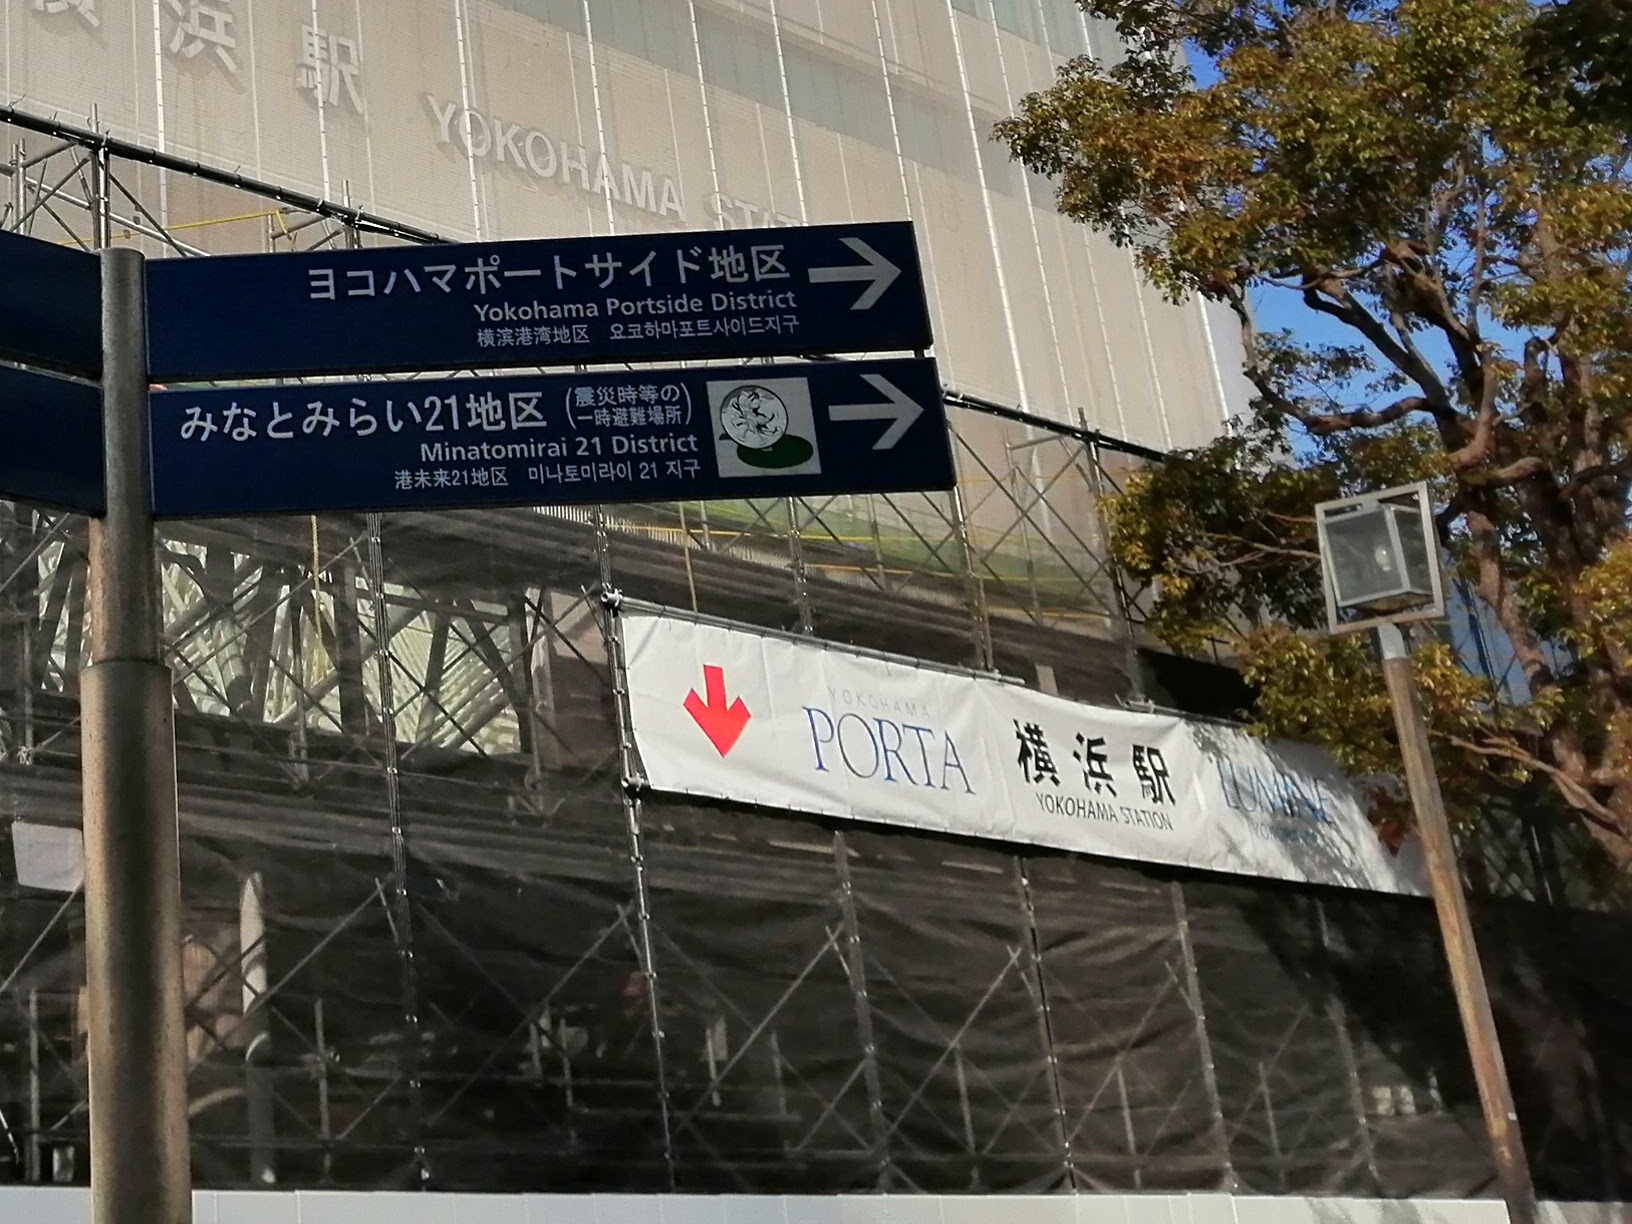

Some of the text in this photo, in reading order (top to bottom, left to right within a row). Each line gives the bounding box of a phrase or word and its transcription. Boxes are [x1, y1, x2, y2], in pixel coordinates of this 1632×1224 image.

[425, 94, 687, 222] YOKOHAMA
[308, 244, 791, 301] ヨコハマポートサイド地区
[473, 290, 797, 323] Yokohama Portside District
[477, 325, 591, 349] 横滨港湾地区
[609, 315, 800, 342] 요코하마포트사이드지구
[181, 390, 548, 443] みなとみらい21地区
[420, 432, 698, 463] Minatomirai 21 District
[394, 466, 509, 491] 港未来21地区
[528, 458, 702, 486] 미나토미라이 21 지구
[828, 686, 932, 719] YOKOHAMA
[802, 705, 976, 796] PORTA
[1013, 718, 1177, 807] 横浜駅
[1035, 791, 1174, 831] YOKOHAMA STATION
